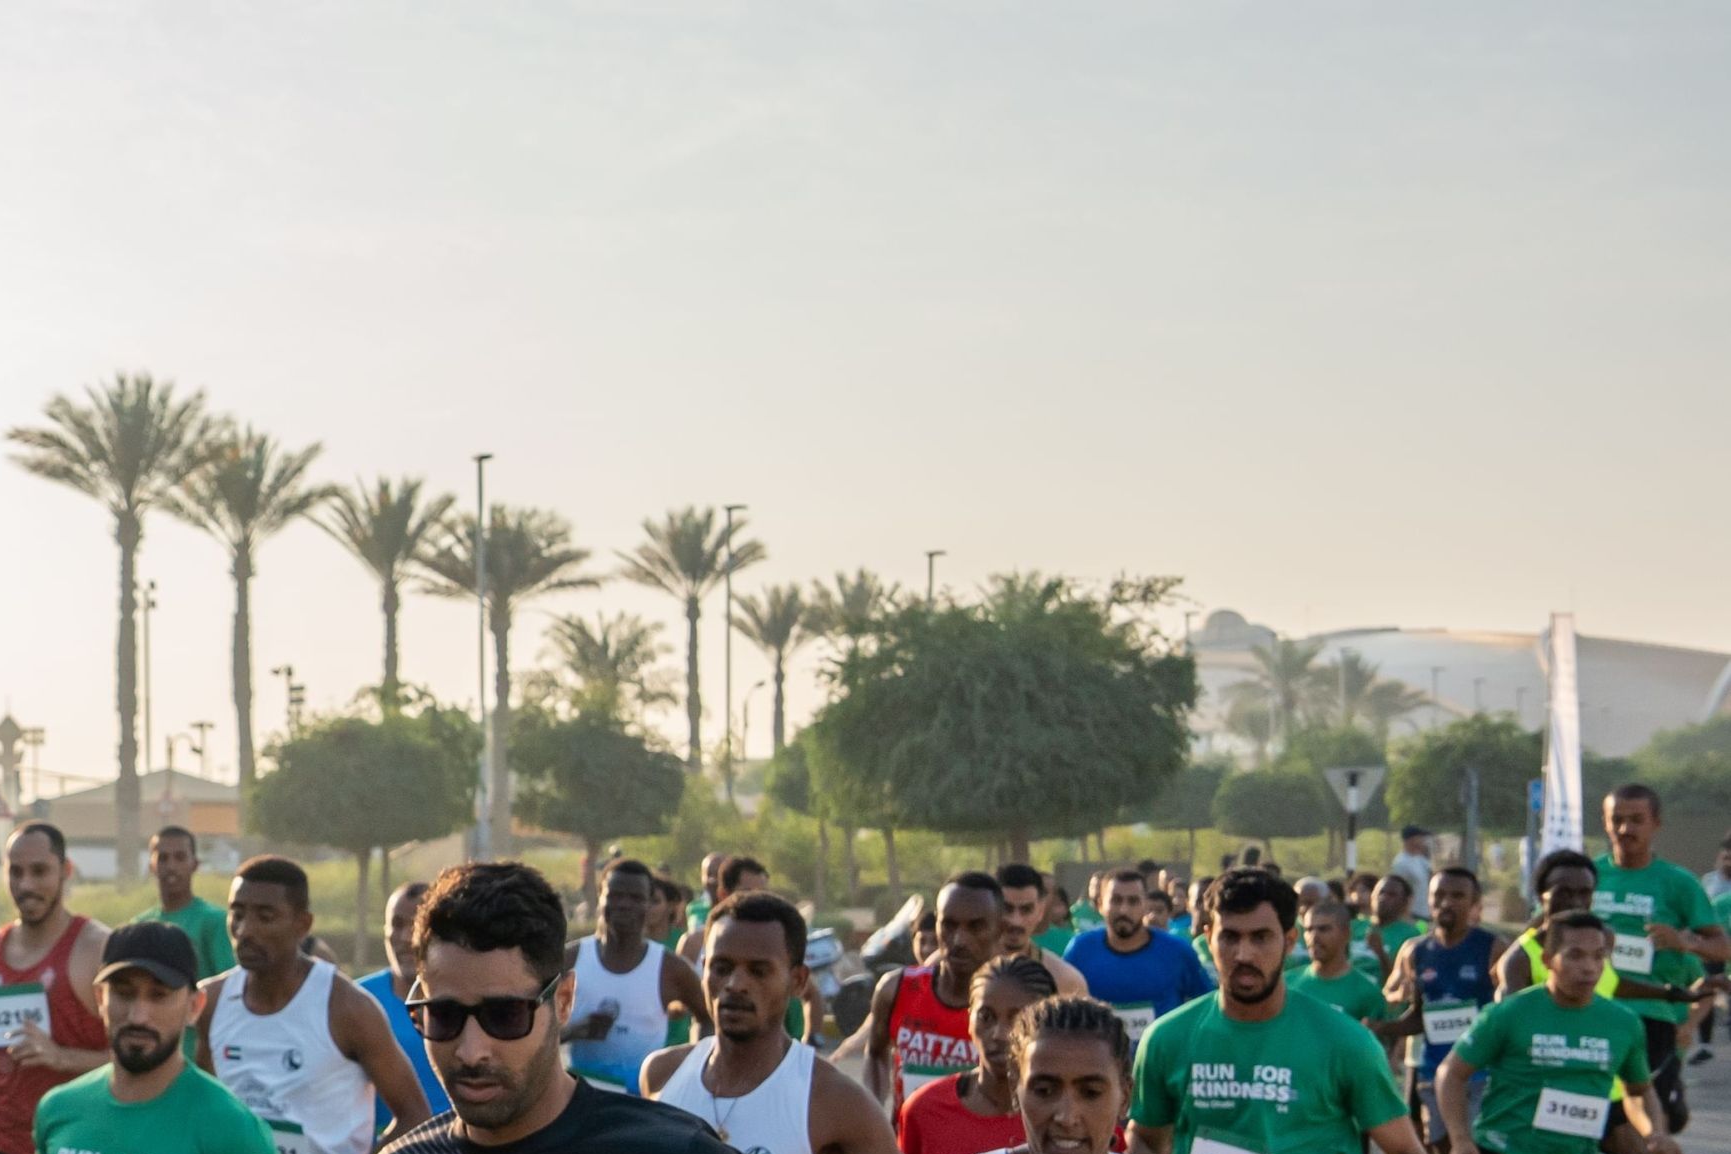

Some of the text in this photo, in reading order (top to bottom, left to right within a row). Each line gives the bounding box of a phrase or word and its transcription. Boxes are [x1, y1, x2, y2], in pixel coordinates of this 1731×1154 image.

[1191, 1063, 1292, 1085] RUN FOR
[1191, 1081, 1290, 1103] KINDNESS
